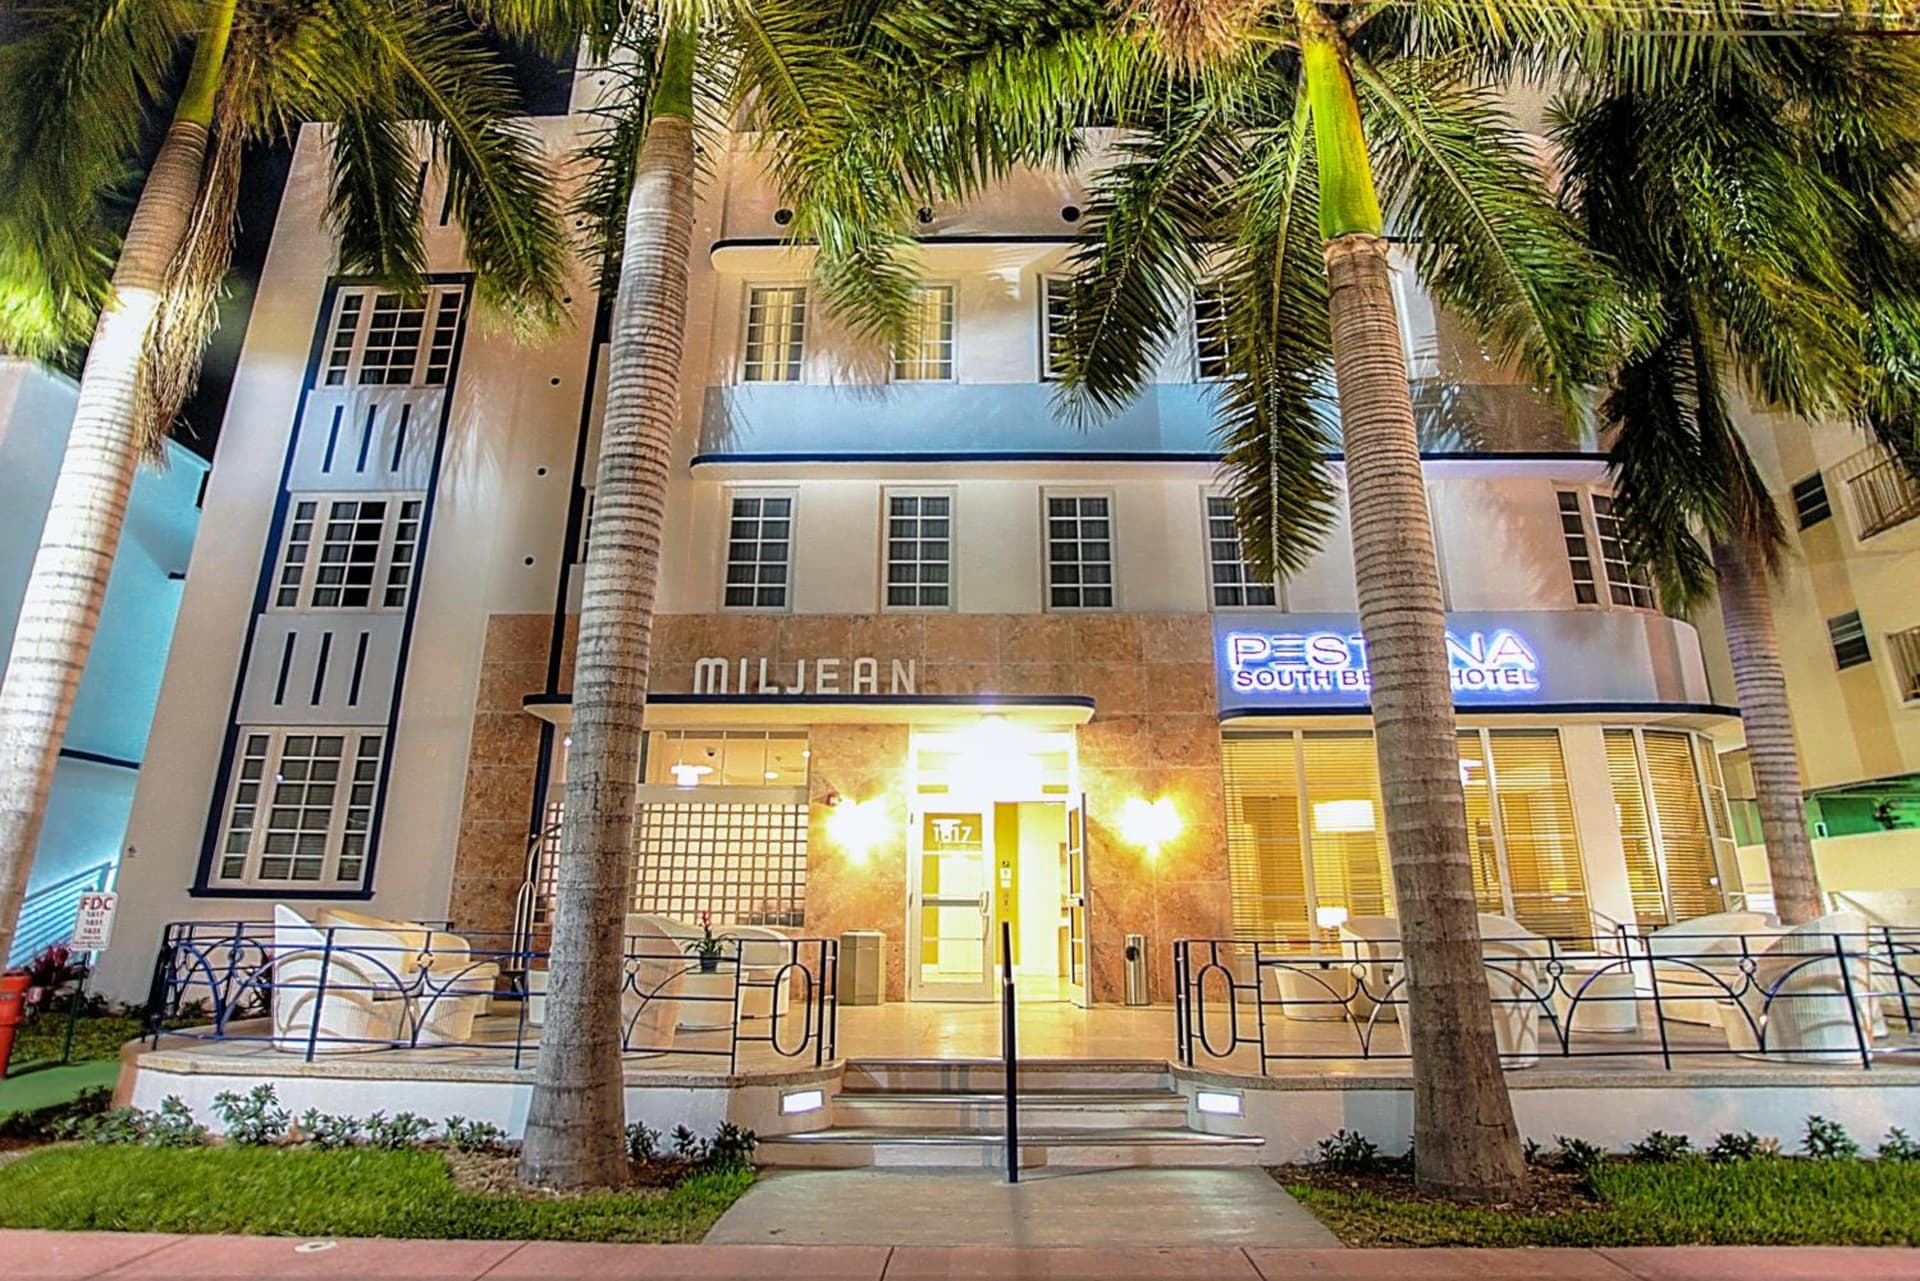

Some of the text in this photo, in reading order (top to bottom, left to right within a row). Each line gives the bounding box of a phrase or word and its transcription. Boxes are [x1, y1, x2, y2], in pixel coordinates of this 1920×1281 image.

[1232, 632, 1536, 666] PESNA
[693, 656, 916, 695] MILJEAN
[1236, 669, 1331, 687] SOUTH
[1449, 668, 1536, 686] HOTEL
[80, 896, 113, 911] FDC
